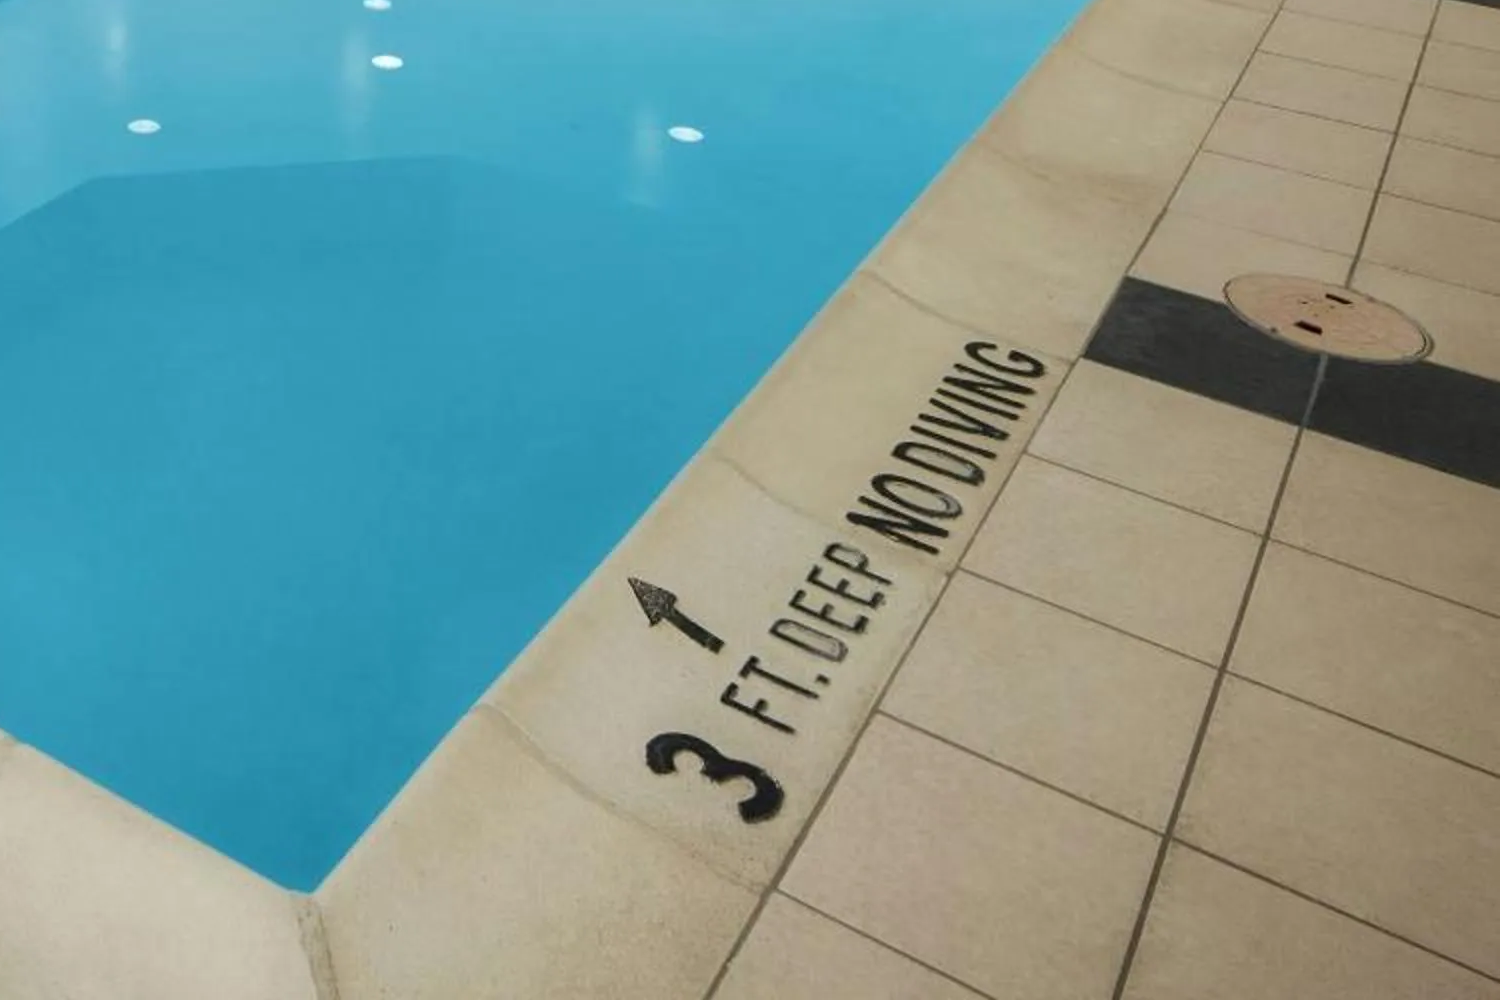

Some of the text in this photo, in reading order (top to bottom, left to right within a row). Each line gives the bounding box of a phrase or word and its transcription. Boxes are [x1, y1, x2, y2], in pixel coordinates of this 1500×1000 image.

[891, 340, 1047, 488] DIVING
[845, 472, 964, 556] NO
[768, 541, 894, 664] DEEP
[645, 731, 786, 824] 3
